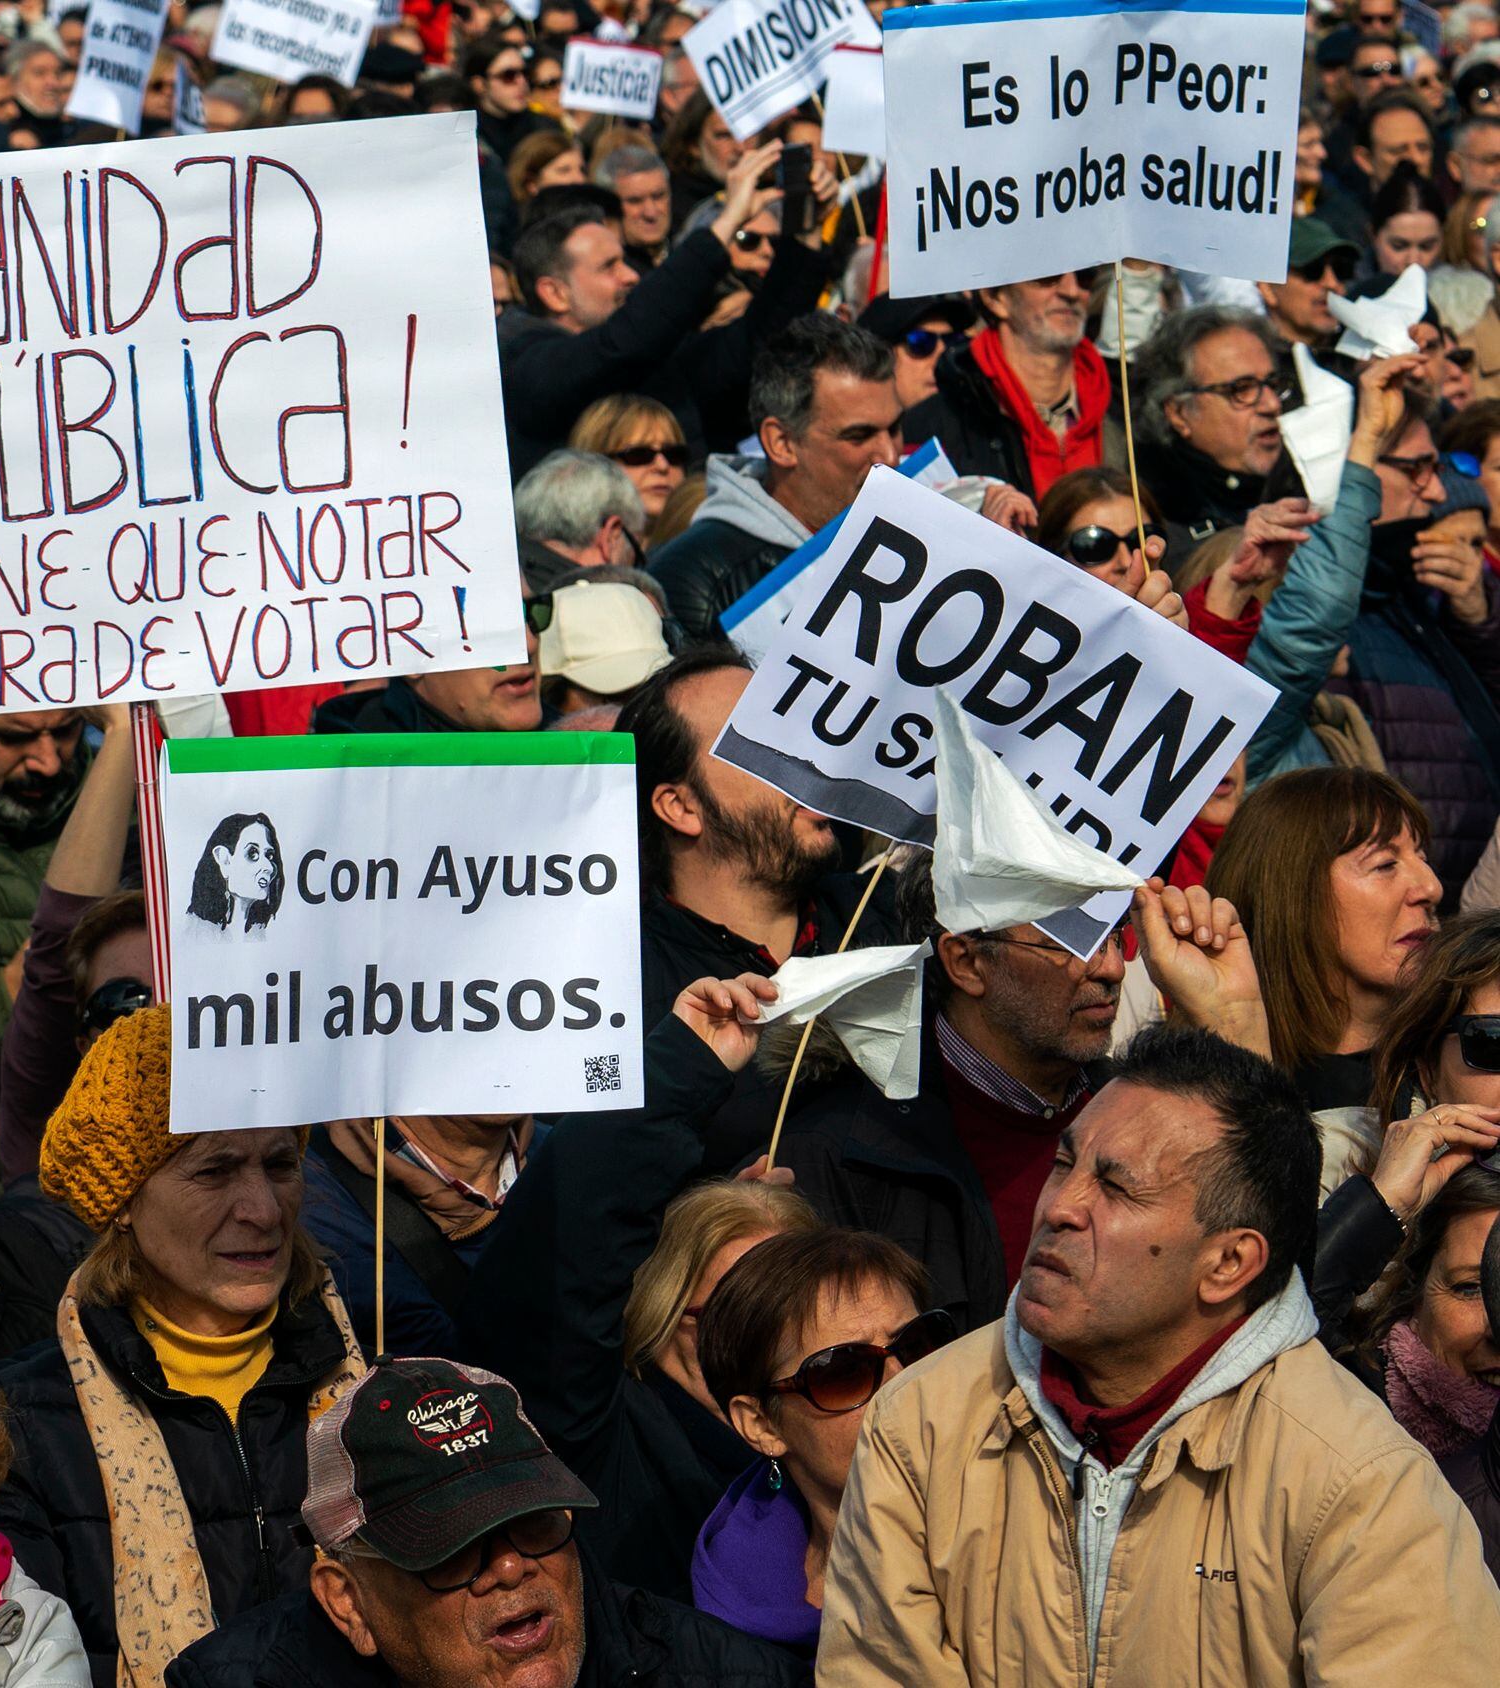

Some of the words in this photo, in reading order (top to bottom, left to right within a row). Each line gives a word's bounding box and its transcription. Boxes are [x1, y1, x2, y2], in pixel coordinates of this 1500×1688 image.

[962, 61, 1020, 129] Es
[1050, 55, 1089, 120] lo
[1115, 42, 1268, 114] PPeor:
[916, 166, 1020, 252] ¡Nos
[1035, 146, 1125, 219] roba
[1140, 145, 1282, 214] salud!
[772, 654, 880, 747] TU
[804, 515, 1237, 827] ROBAN
[297, 848, 399, 905] Con
[418, 845, 618, 914] Ayuso
[187, 970, 301, 1050] mil
[323, 964, 627, 1041] abusos.
[407, 1392, 479, 1425] Chicago
[440, 1429, 490, 1457] 1837
[1202, 1566, 1238, 1582] LFIG
